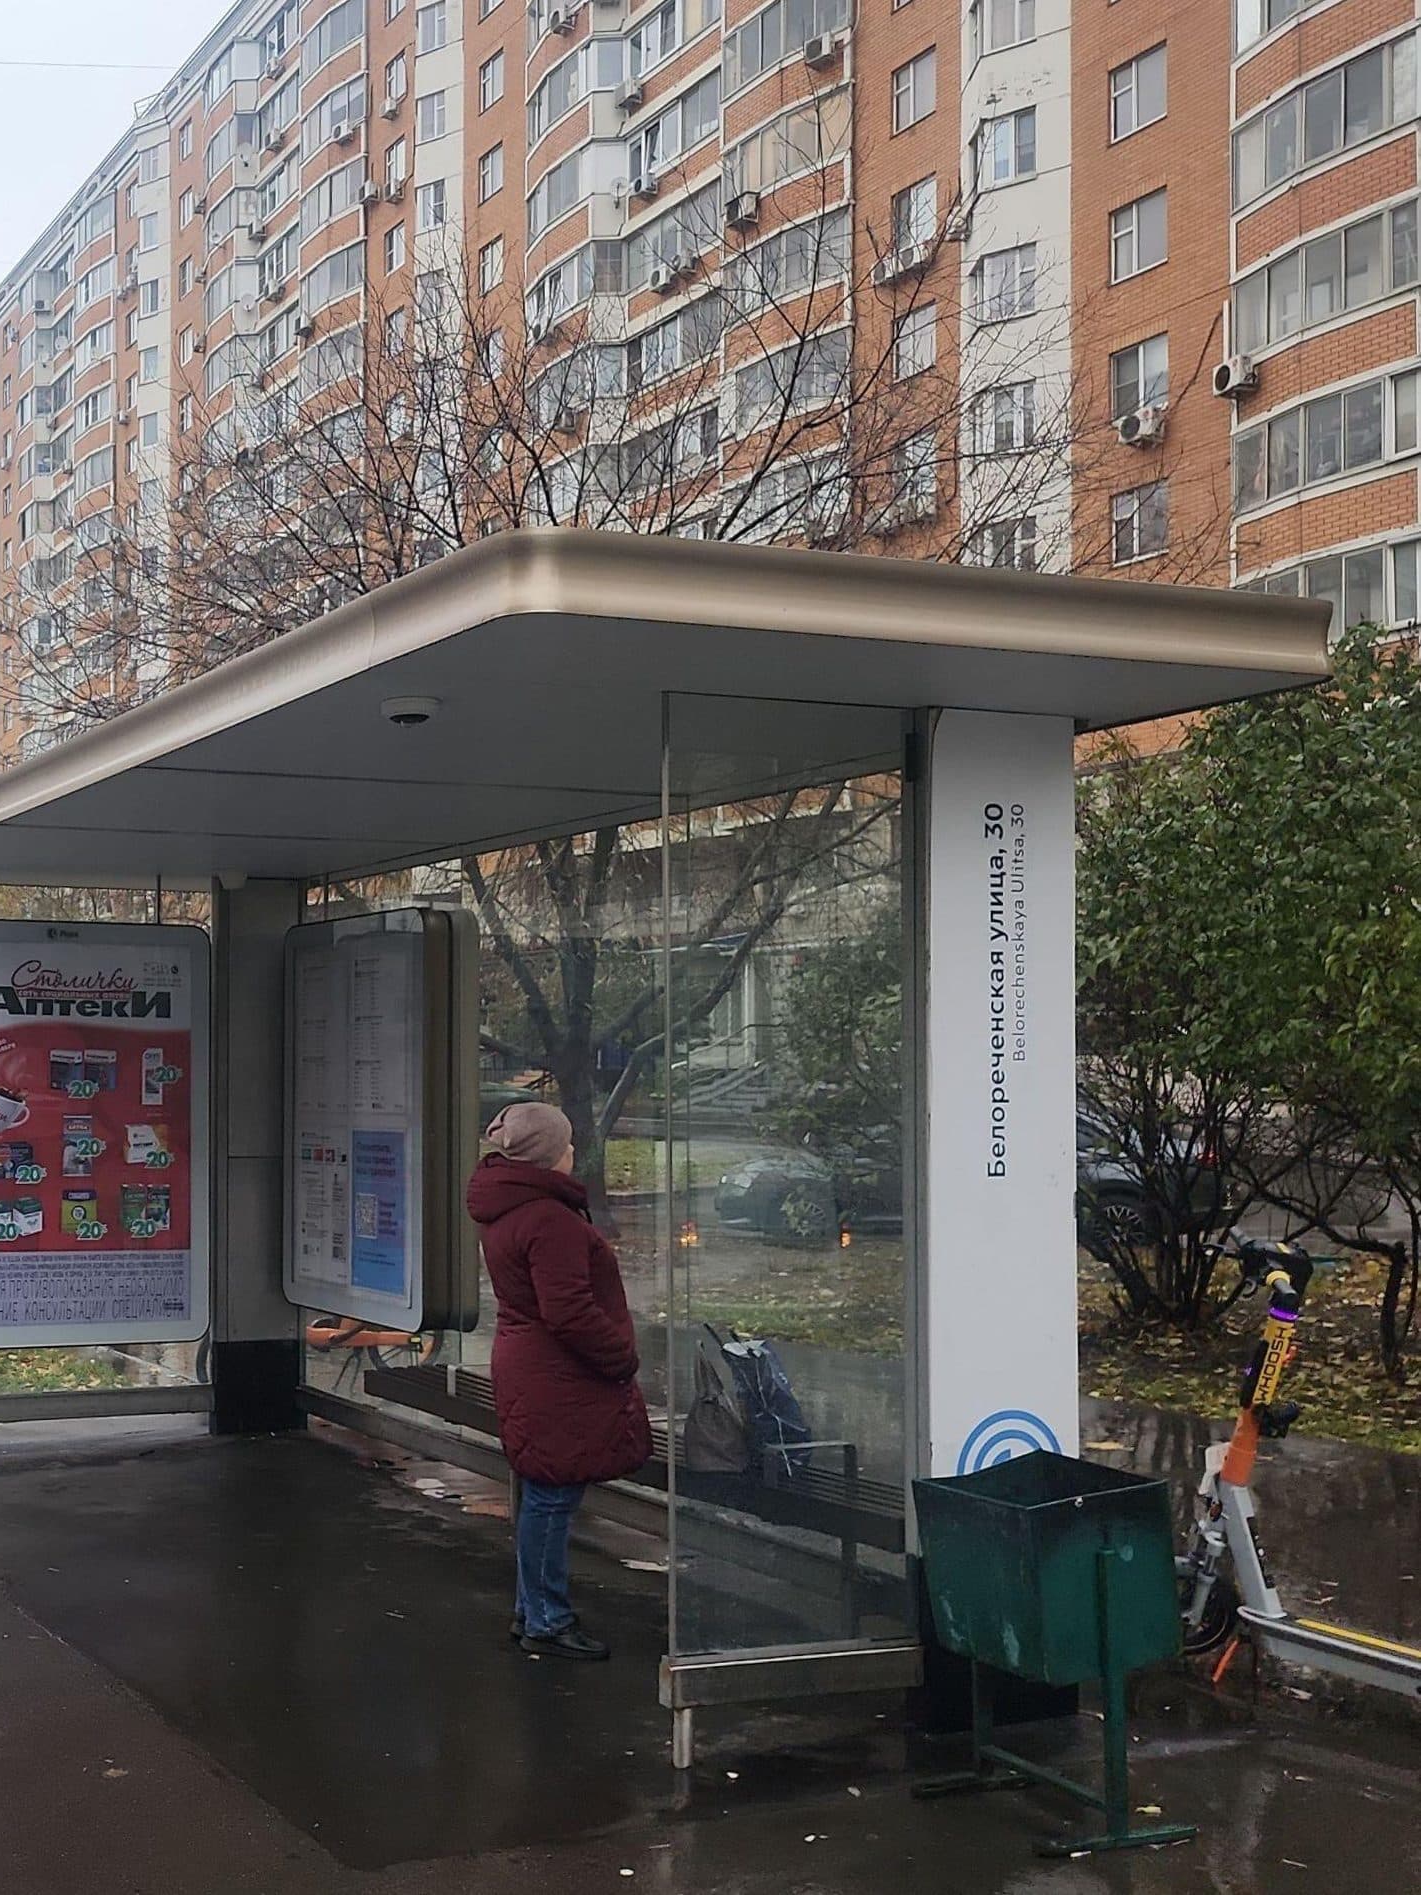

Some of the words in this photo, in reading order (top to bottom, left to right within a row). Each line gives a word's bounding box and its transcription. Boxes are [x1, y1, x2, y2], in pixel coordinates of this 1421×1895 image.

[984, 802, 1004, 840] 30
[1011, 804, 1025, 827] 30
[1011, 833, 1026, 893] Ulitsa,
[989, 846, 1009, 942] улица,
[11, 959, 140, 991] Столички
[1011, 899, 1028, 1062] Belorechenskaya
[987, 950, 1010, 1179] Белореченская
[25, 1300, 106, 1321] КОНСУЛЬТАЦИИ
[1254, 1327, 1286, 1402] WHOOSH
